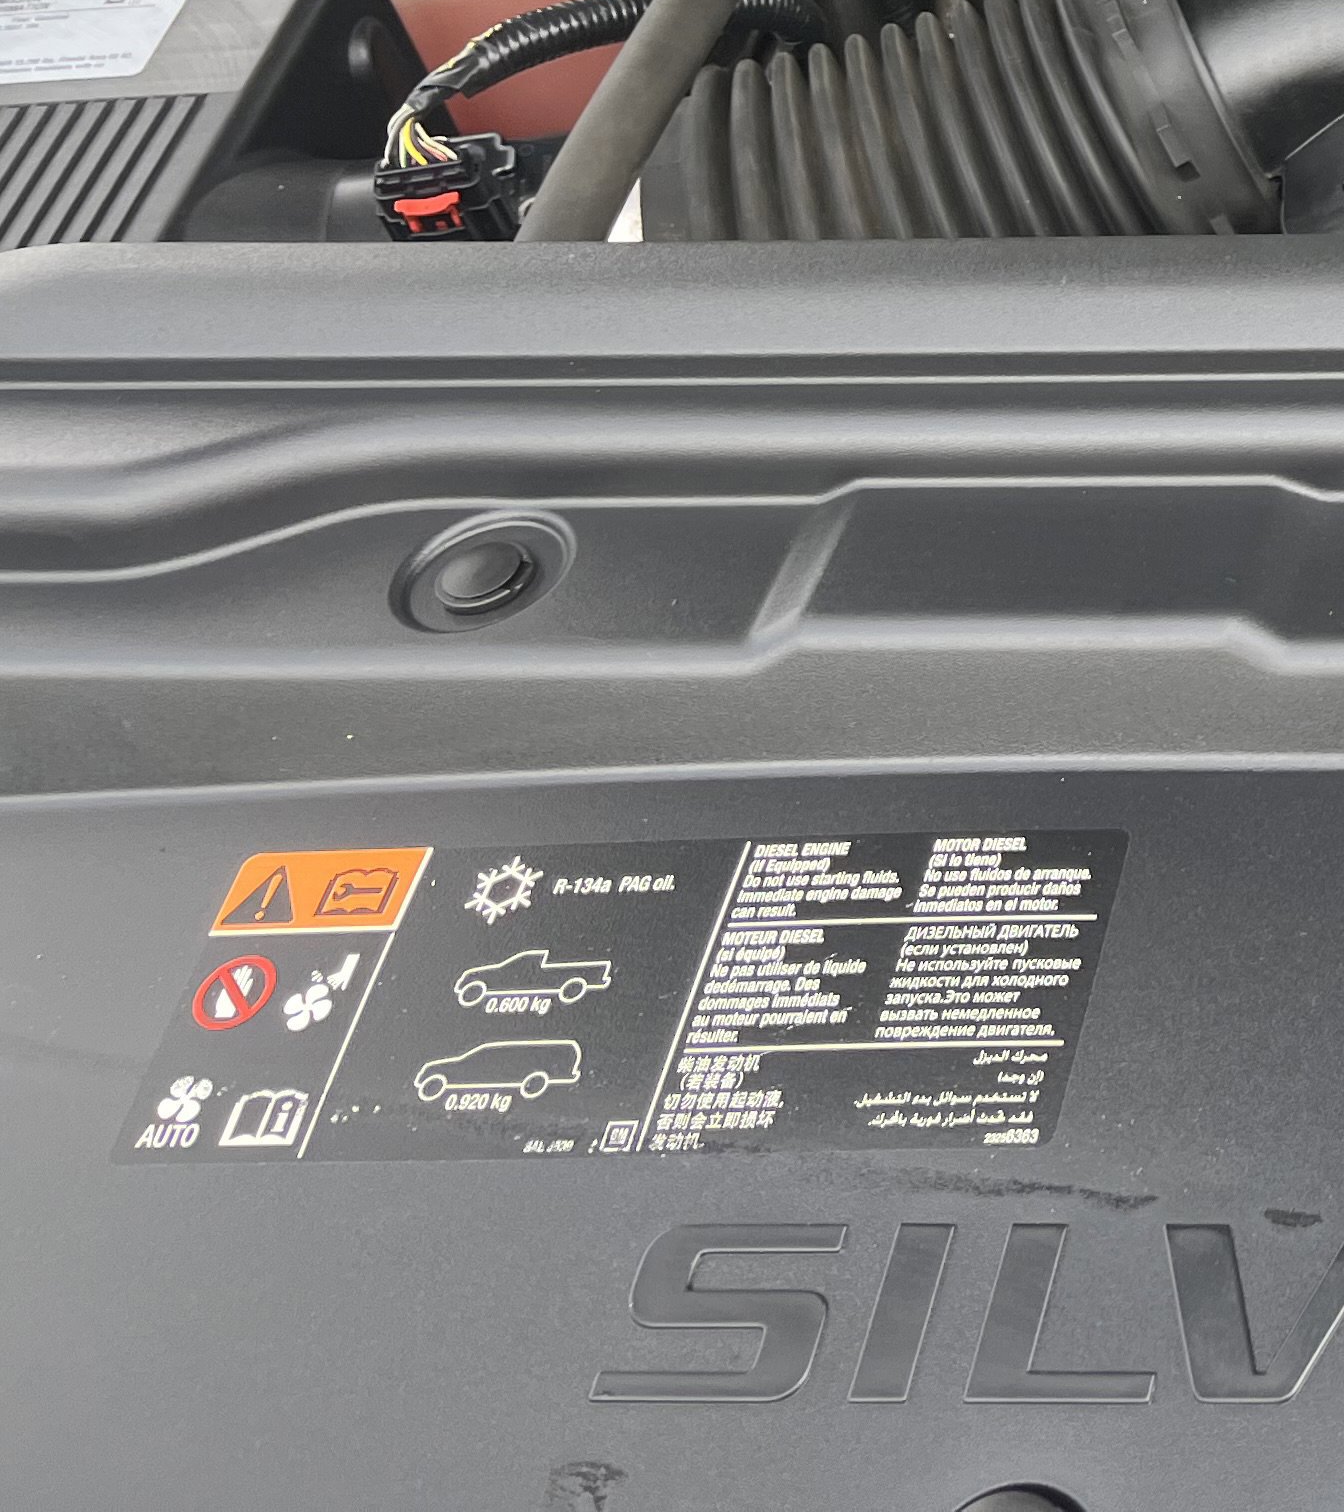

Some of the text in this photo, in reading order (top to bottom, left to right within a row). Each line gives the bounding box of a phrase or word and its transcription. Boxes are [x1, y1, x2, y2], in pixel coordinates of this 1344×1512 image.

[754, 842, 852, 858] DIESEL ENGINE
[933, 837, 1027, 852] MOTOR DIESEL
[748, 857, 831, 874] (If Equipped)
[928, 853, 1002, 869] (Si lo tiene)
[742, 870, 900, 888] Do not use starting fluids.
[923, 867, 1092, 883] No use fluidos de arranque.
[552, 874, 676, 895] R-134a PAG oil.
[918, 881, 1082, 899] Se pueden producir daños
[806, 887, 849, 904] engine
[851, 886, 903, 902] damage
[731, 903, 797, 918] can result.
[985, 900, 1003, 911] en
[1004, 898, 1018, 911] el
[1019, 898, 1059, 911] motor.
[721, 928, 825, 946] MOTEUR DIESEL
[903, 923, 1080, 942] ДИЗЕЛЬНЫЙ ДВИГАТЕЛЬ
[716, 945, 786, 963] (si équipé)
[900, 940, 1029, 958] (если установлен)
[710, 963, 728, 977] Ne
[730, 964, 755, 979] pas
[757, 961, 802, 976] utiliser
[803, 960, 820, 975] de
[895, 957, 1082, 973] Не используйте пусковые
[795, 977, 821, 991] Des
[888, 974, 1070, 990] жидкости для холодного
[485, 996, 552, 1015] 0.600 kg
[698, 992, 841, 1011] dommages immédiats
[972, 991, 1021, 1003] может
[692, 1009, 848, 1028] au moteur pourraient en
[879, 1007, 1041, 1022] вызвать немедленное
[686, 1029, 739, 1044] résulter.
[874, 1023, 1055, 1040] повреждение двигателя.
[676, 1054, 761, 1074] 柴油发动机
[973, 1050, 1049, 1065] محرك الديزل
[444, 1093, 512, 1112] 0.920 kg
[973, 1091, 1027, 1106] تستخدم
[1029, 1089, 1040, 1103] لا
[656, 1110, 776, 1130] 否则会立即损坏
[135, 1124, 200, 1149] AUTO
[609, 1128, 629, 1144] GM
